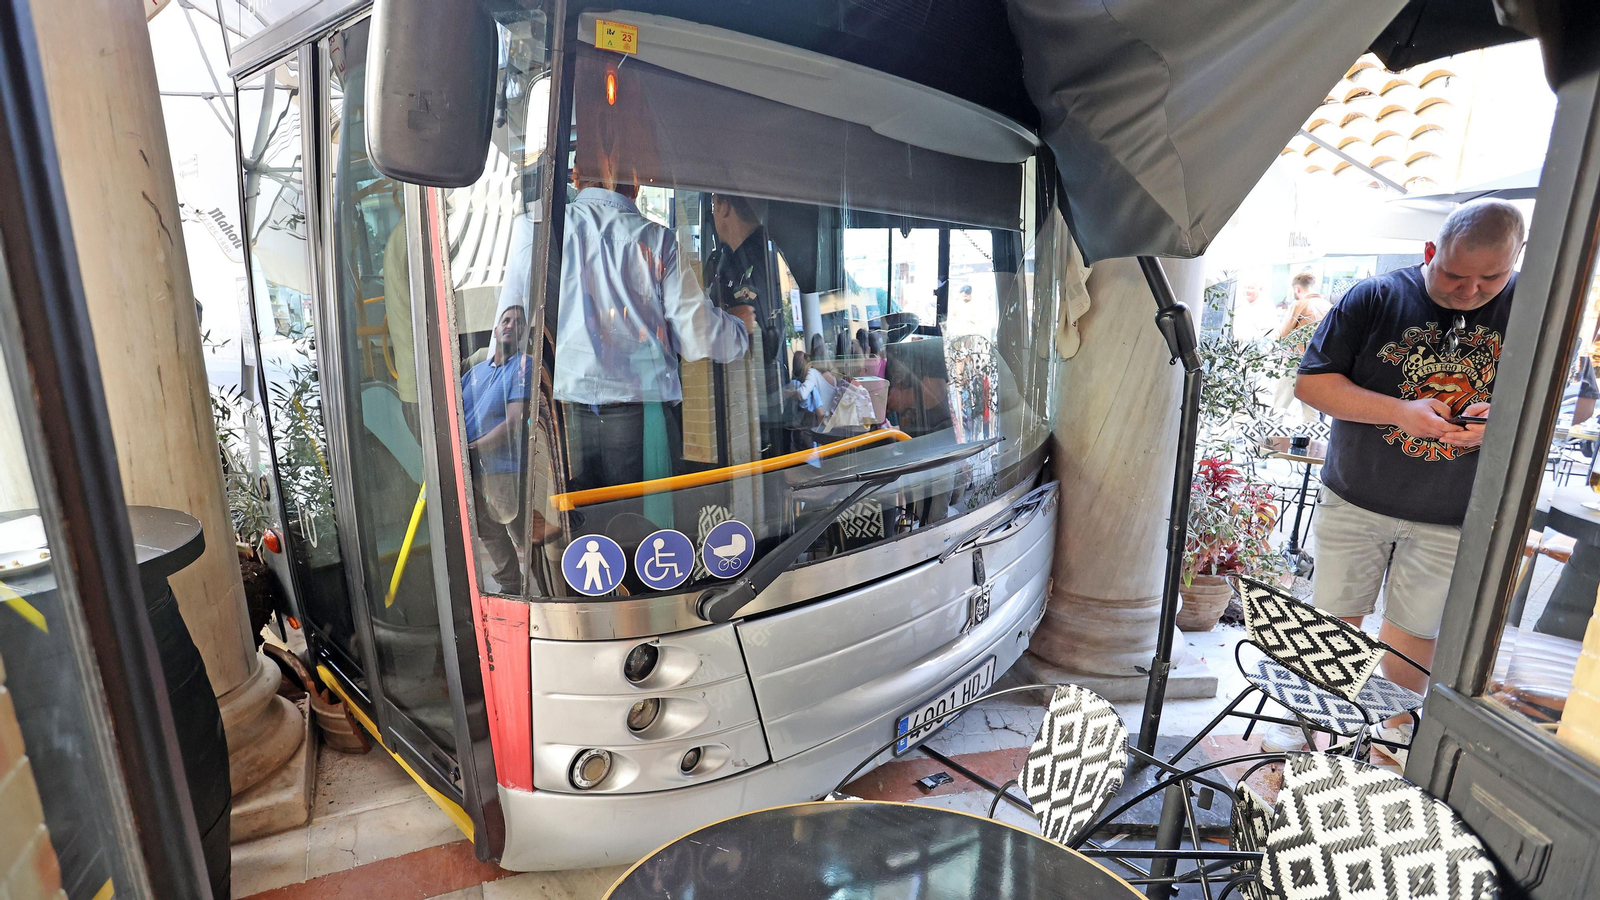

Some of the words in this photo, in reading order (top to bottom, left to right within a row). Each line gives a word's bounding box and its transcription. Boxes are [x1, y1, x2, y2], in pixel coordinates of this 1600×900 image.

[622, 33, 632, 42] 23
[207, 207, 242, 249] Mahou
[962, 665, 990, 704] HDJ
